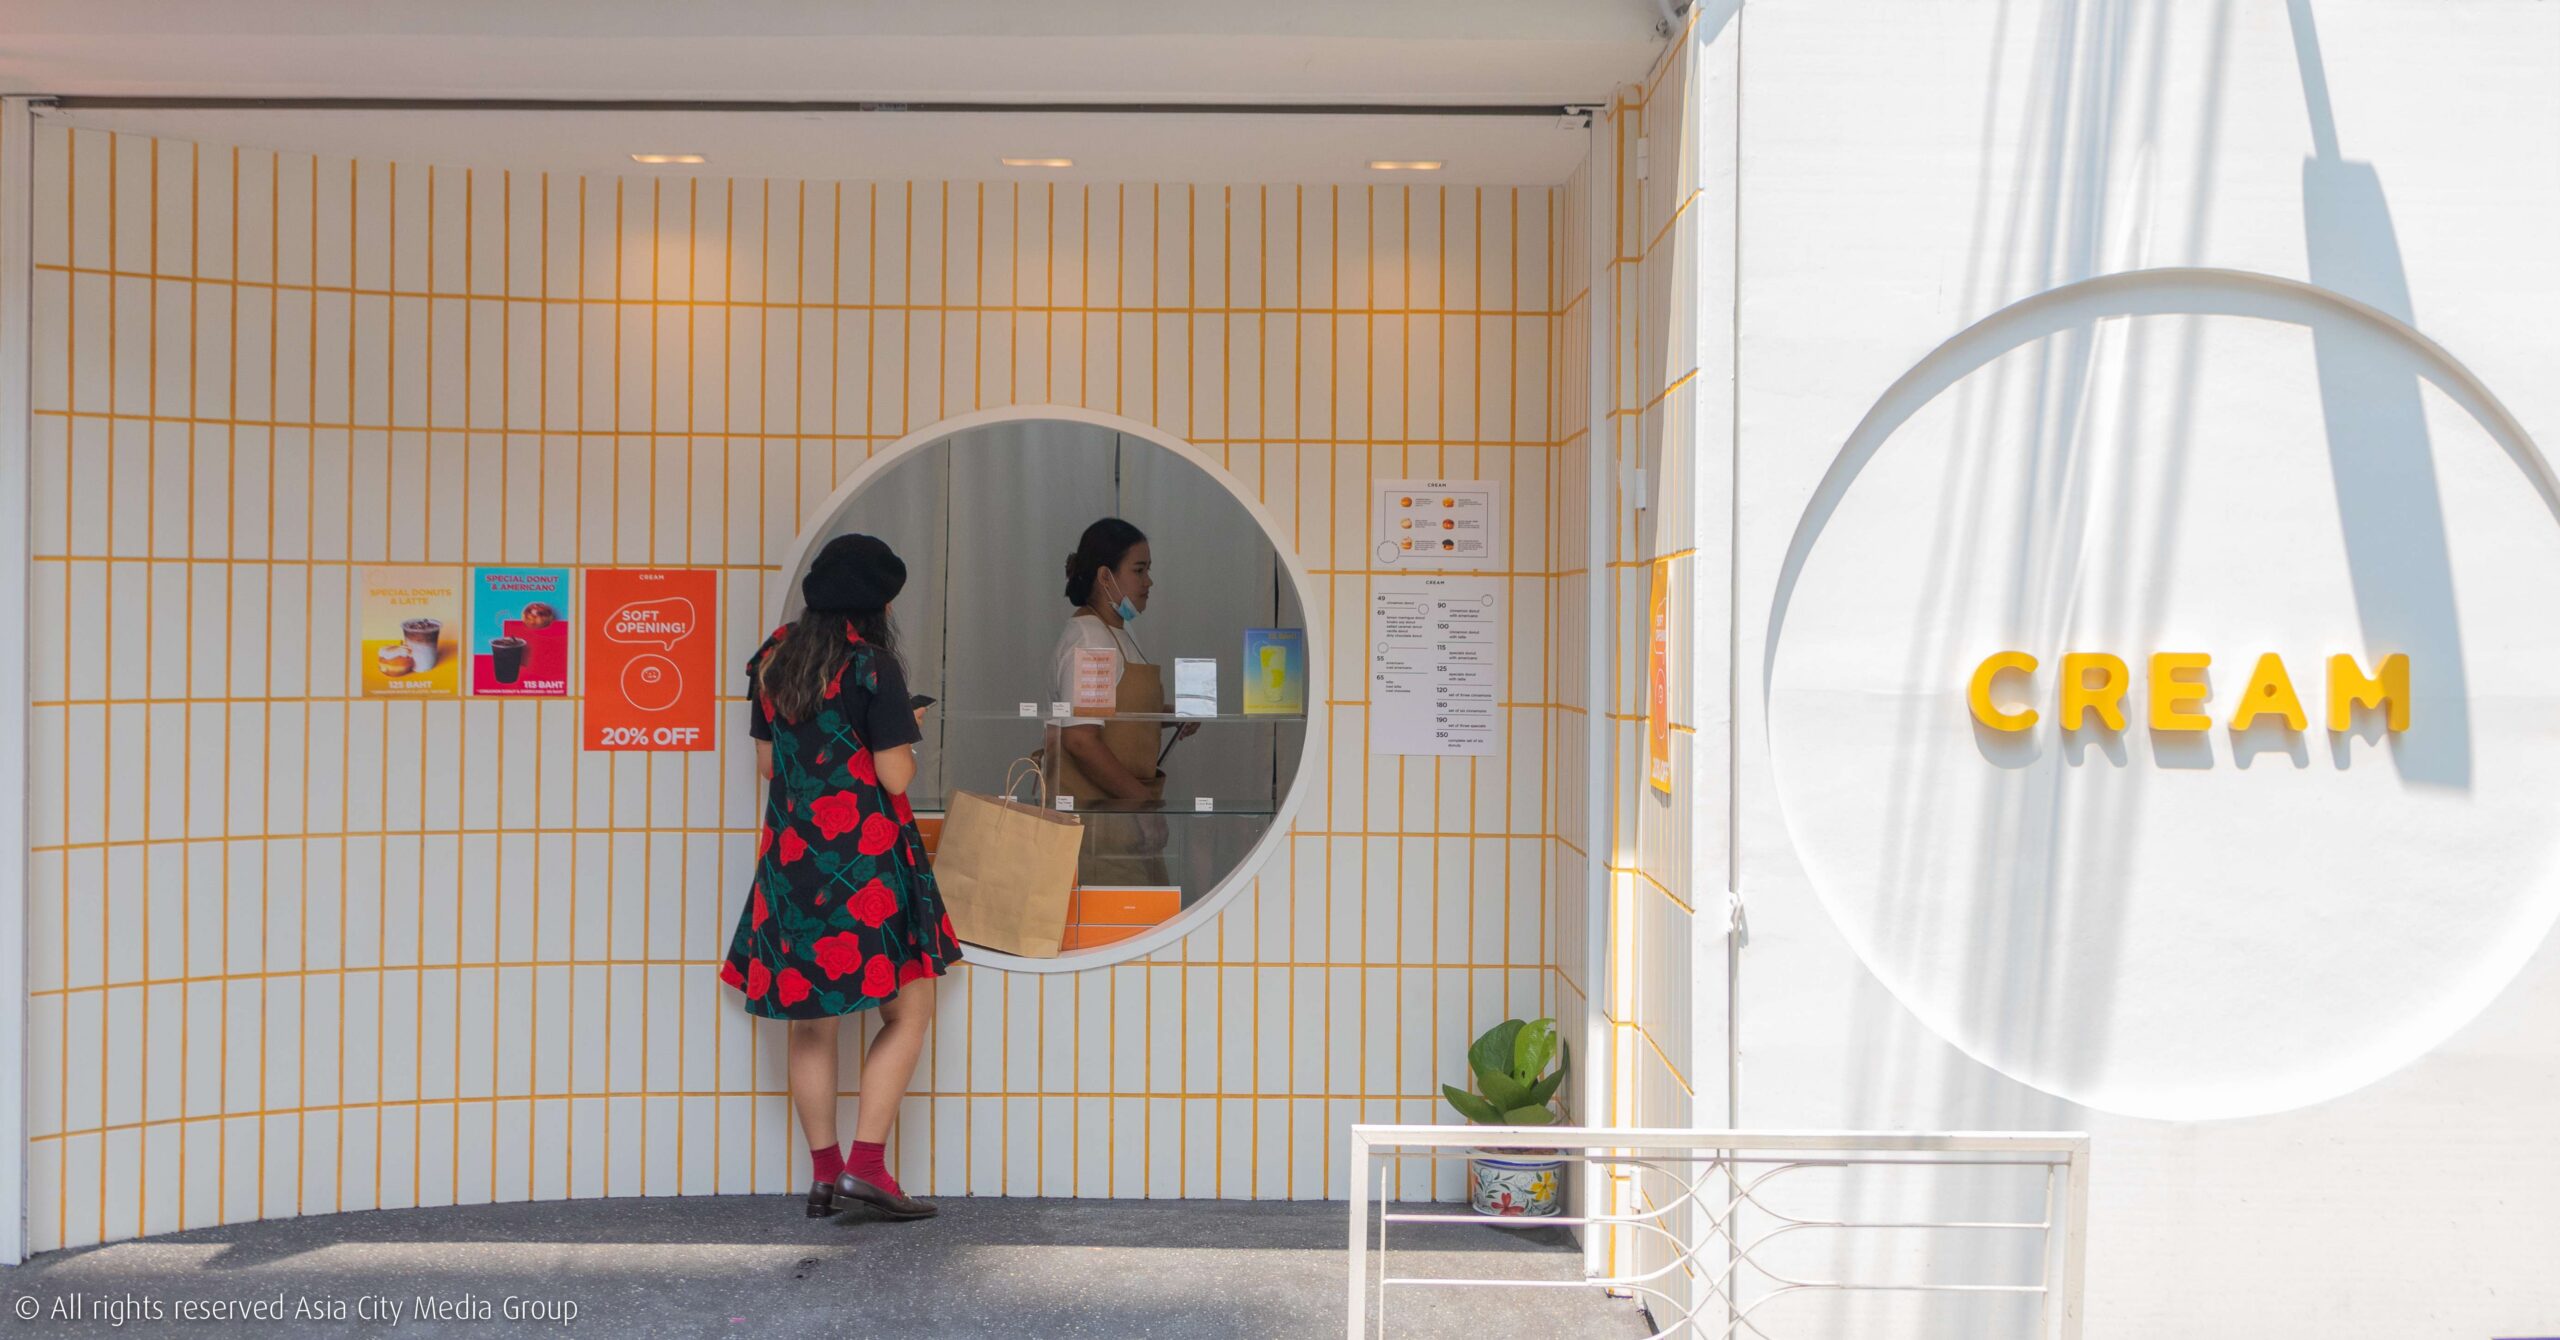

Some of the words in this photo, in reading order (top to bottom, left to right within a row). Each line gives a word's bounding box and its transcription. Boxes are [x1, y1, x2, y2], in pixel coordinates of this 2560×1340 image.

[485, 574, 523, 583] SPECIAL
[526, 575, 559, 583] DONUT
[491, 583, 498, 591] &
[501, 583, 556, 592] AMERICANO
[370, 588, 409, 597] SPECIAL
[411, 589, 452, 597] DONUTS
[400, 598, 430, 606] LATTE
[622, 610, 659, 622] SOFT
[616, 622, 686, 634] OPENING!
[406, 681, 432, 689] BAHT
[523, 681, 536, 689] 115
[538, 681, 564, 689] BAHT
[1968, 650, 2411, 733] CREAM
[601, 727, 649, 745] 20%
[653, 727, 699, 745] OFF
